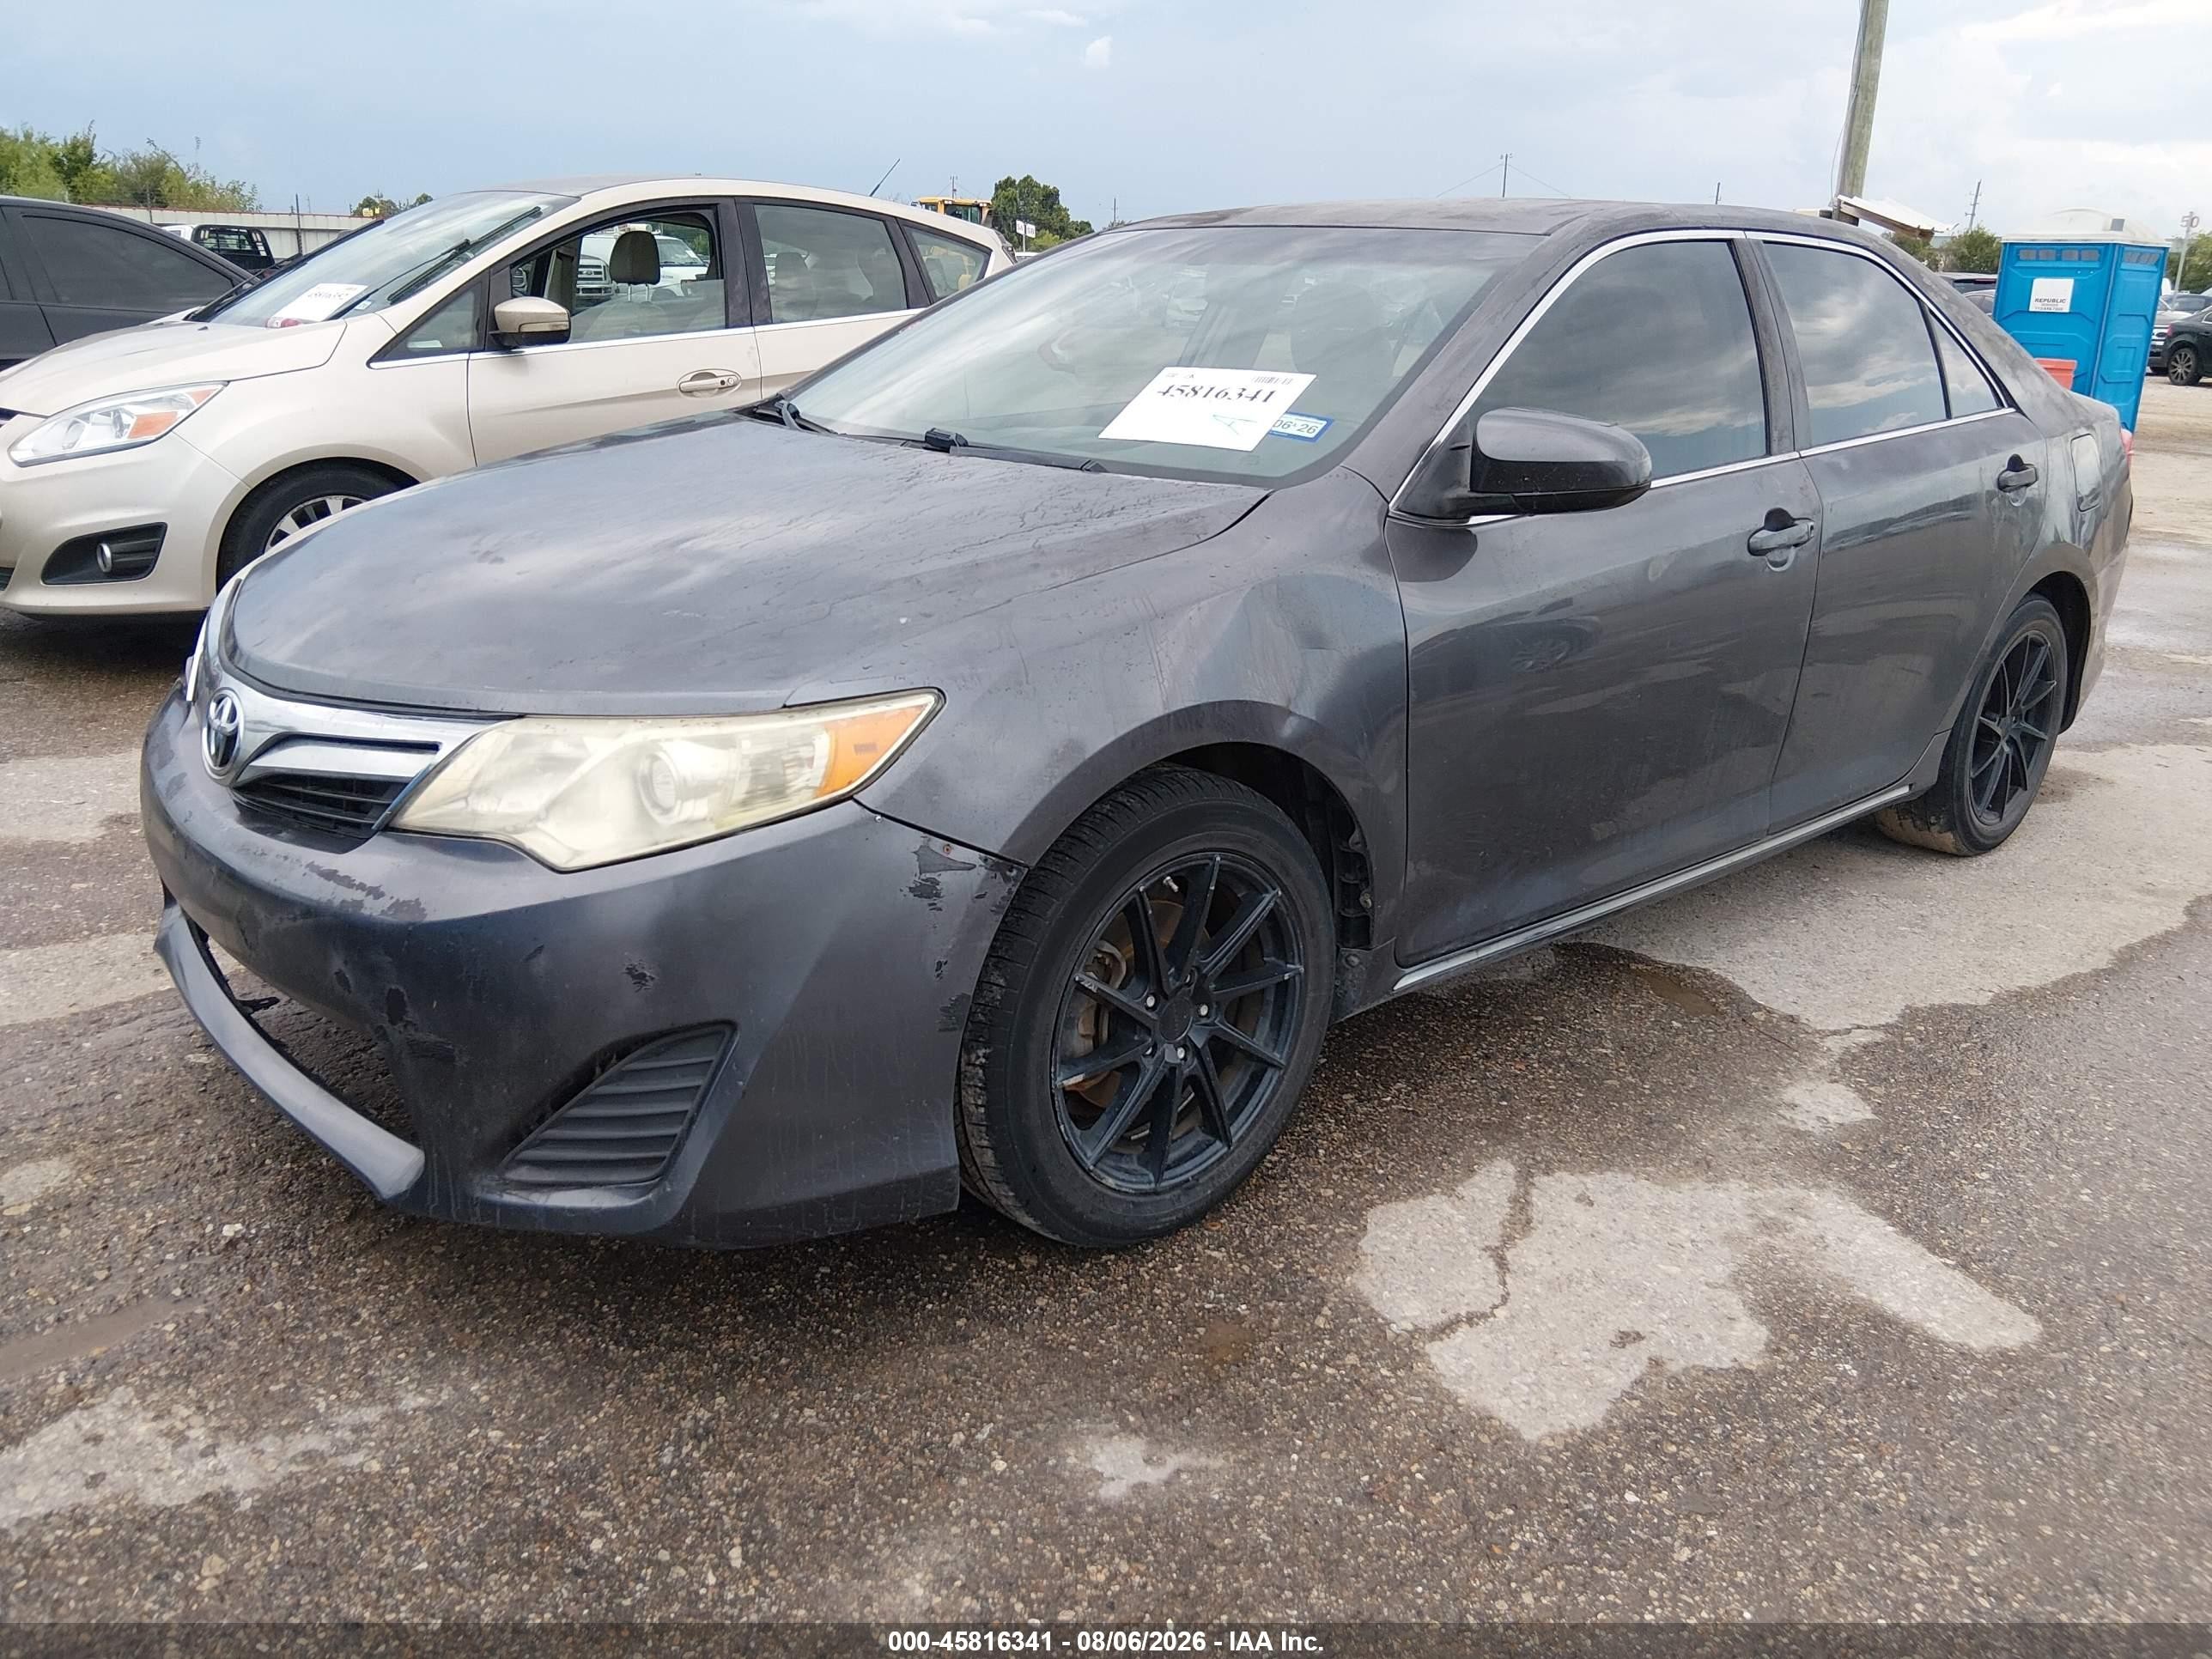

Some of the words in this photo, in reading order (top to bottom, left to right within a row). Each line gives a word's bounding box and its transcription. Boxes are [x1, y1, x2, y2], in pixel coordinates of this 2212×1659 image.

[2180, 216, 2199, 228] 50
[1158, 385, 1276, 403] 45816341
[1273, 419, 1292, 429] 06
[1297, 423, 1319, 434] 26
